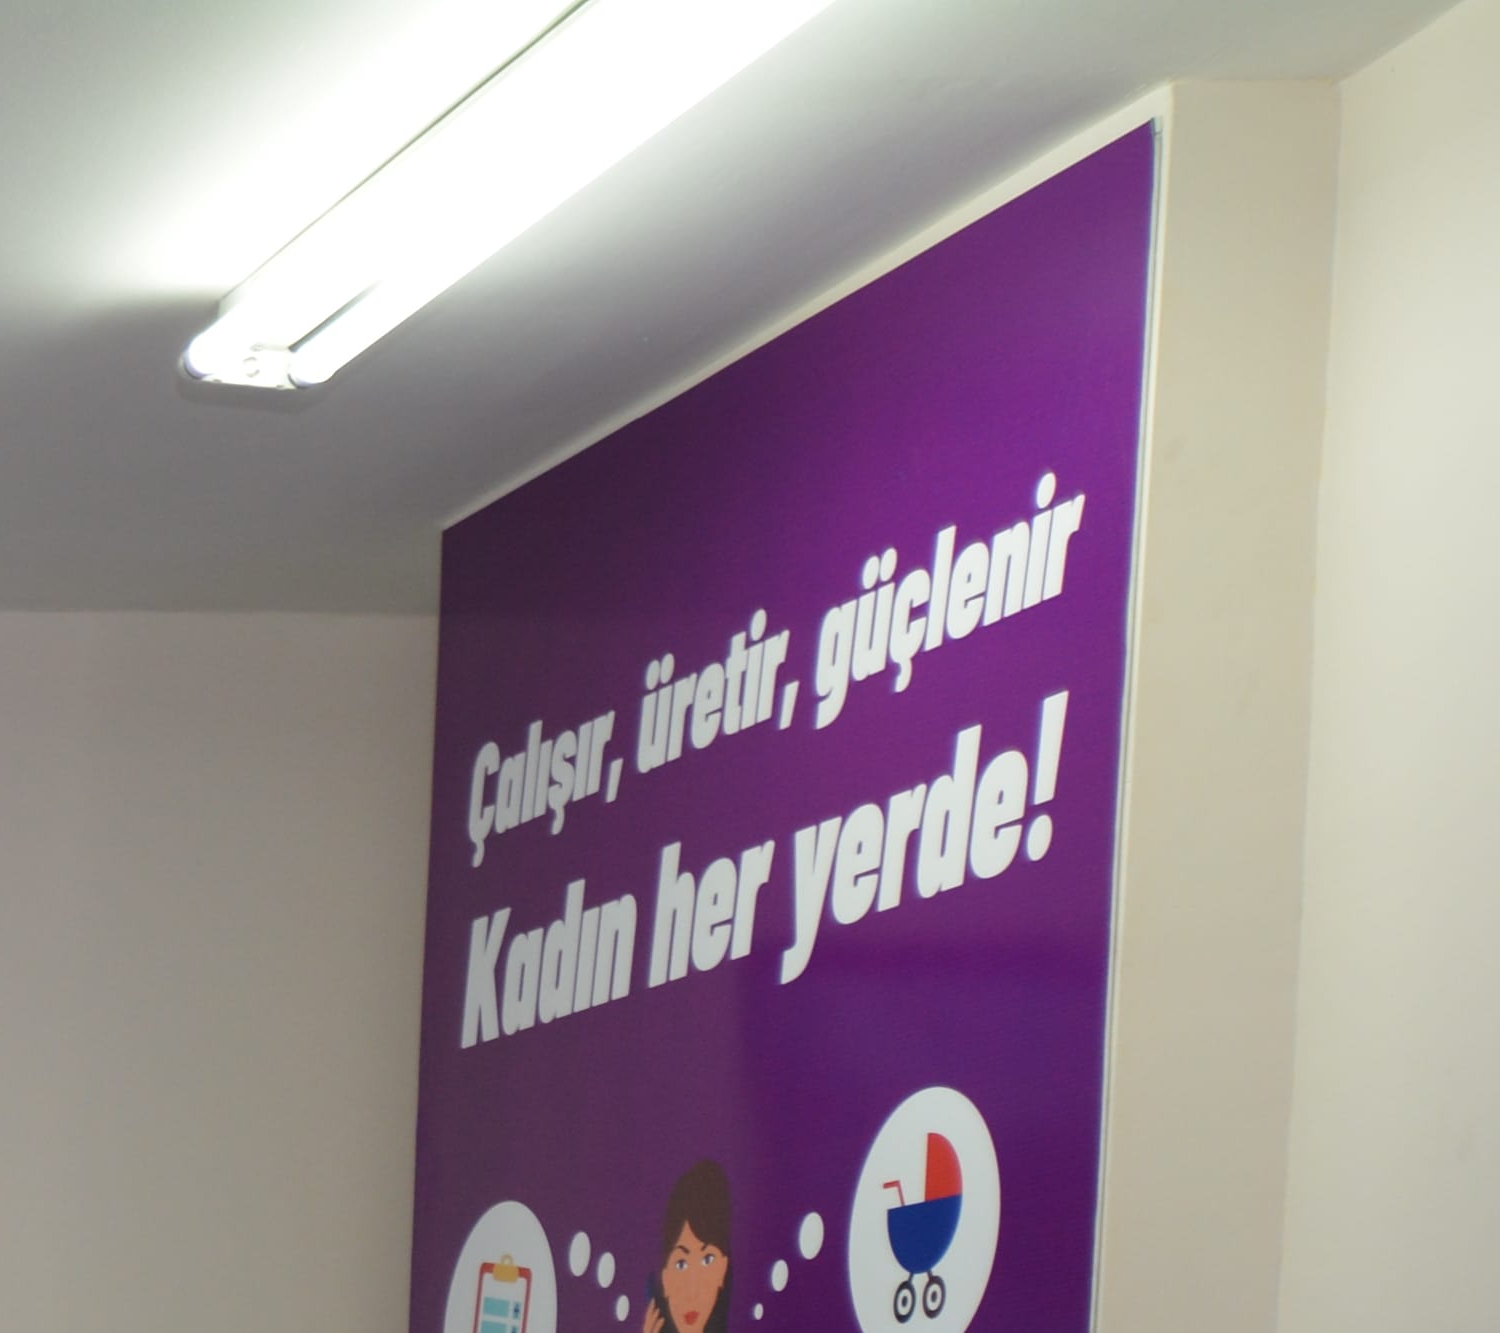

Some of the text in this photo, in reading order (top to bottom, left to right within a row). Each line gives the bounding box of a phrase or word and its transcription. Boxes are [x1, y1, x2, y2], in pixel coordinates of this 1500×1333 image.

[468, 471, 1085, 867] Çalışır, üretir, güçlenir
[461, 689, 1069, 1049] Kadın her yerde!
